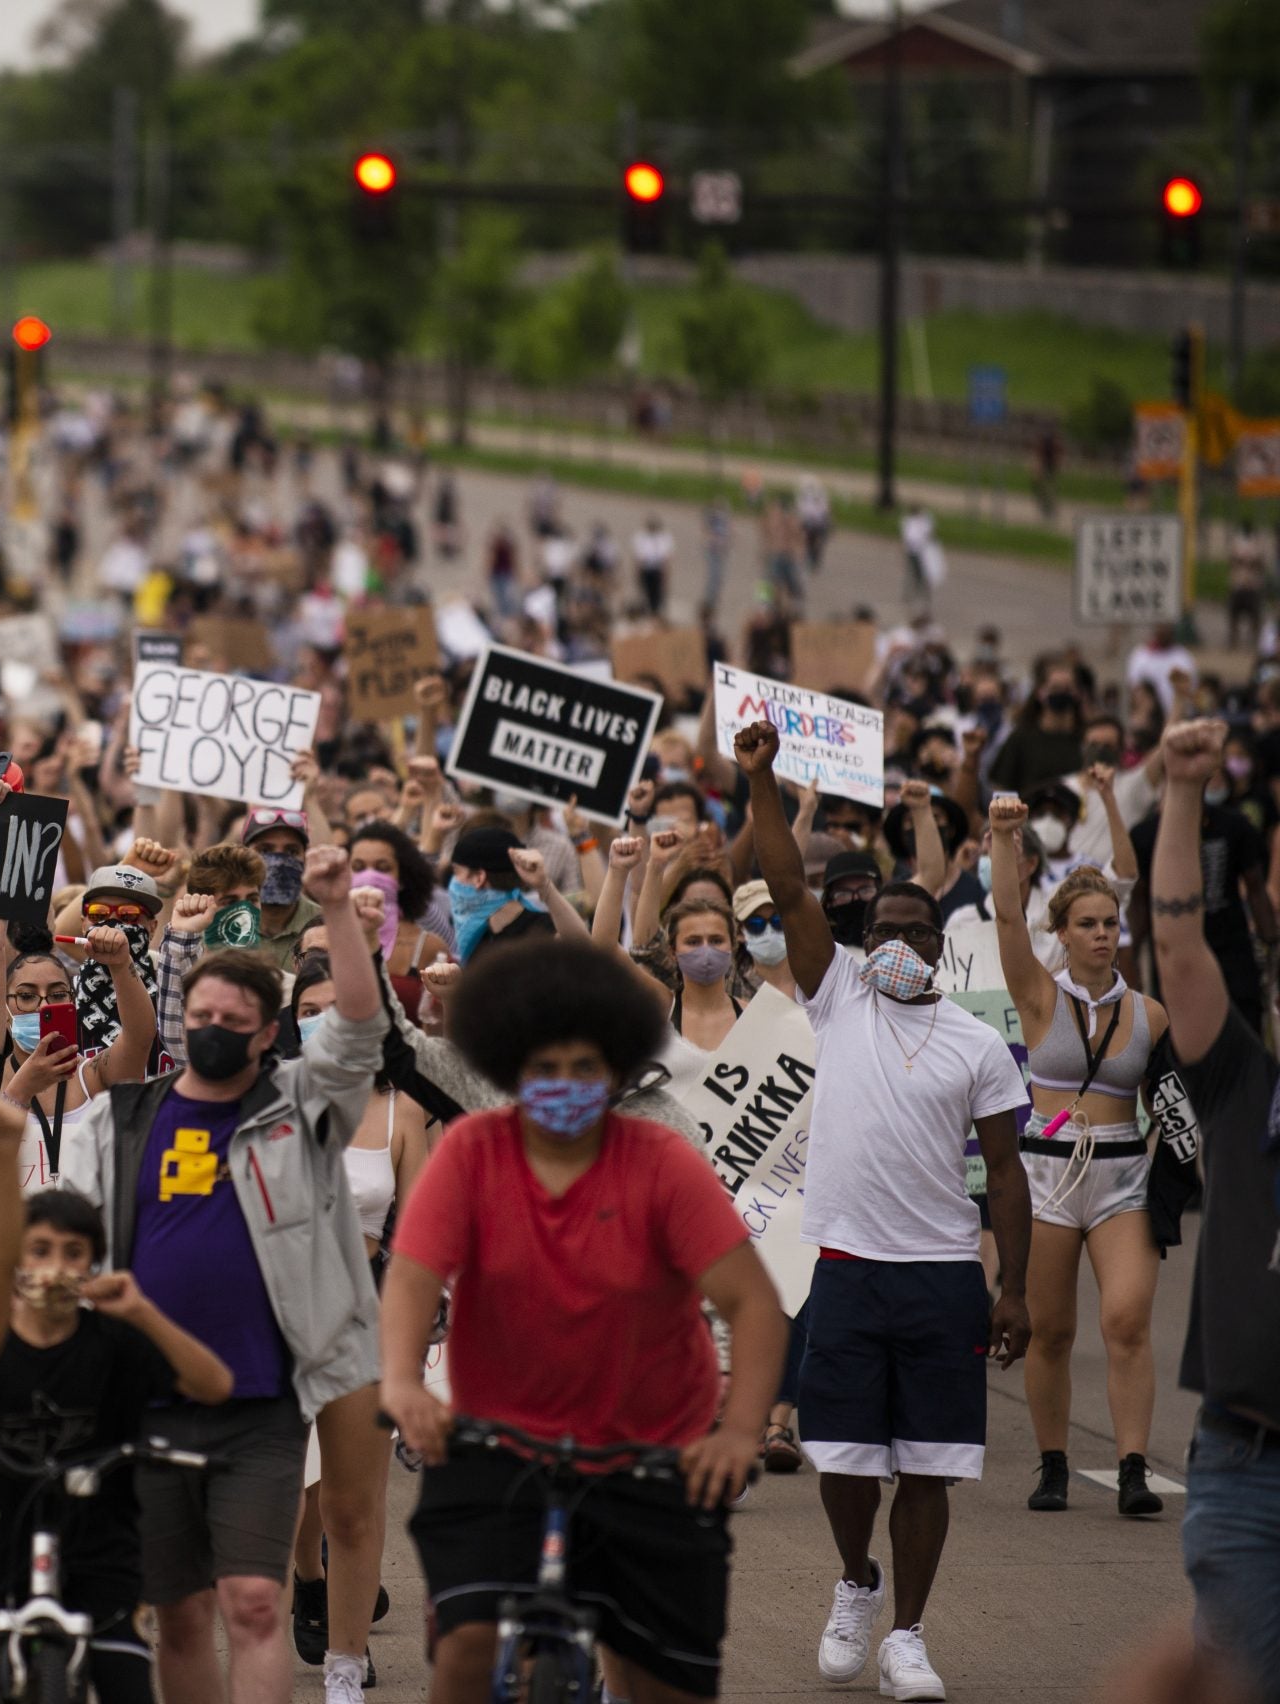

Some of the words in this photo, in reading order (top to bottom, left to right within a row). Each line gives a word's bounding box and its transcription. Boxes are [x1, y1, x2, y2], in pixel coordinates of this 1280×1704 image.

[719, 667, 736, 688] I
[135, 669, 313, 753] GEORGE
[483, 674, 566, 723] BLACK
[570, 701, 639, 745] LIVES
[738, 695, 856, 747] MURDERS
[137, 726, 296, 801] FLOYD
[502, 730, 595, 778] MATTER
[784, 741, 864, 768] ONSIDERED
[703, 1062, 749, 1106] IS
[713, 1053, 816, 1199] ERIKKKA
[761, 1129, 809, 1199] LIVES
